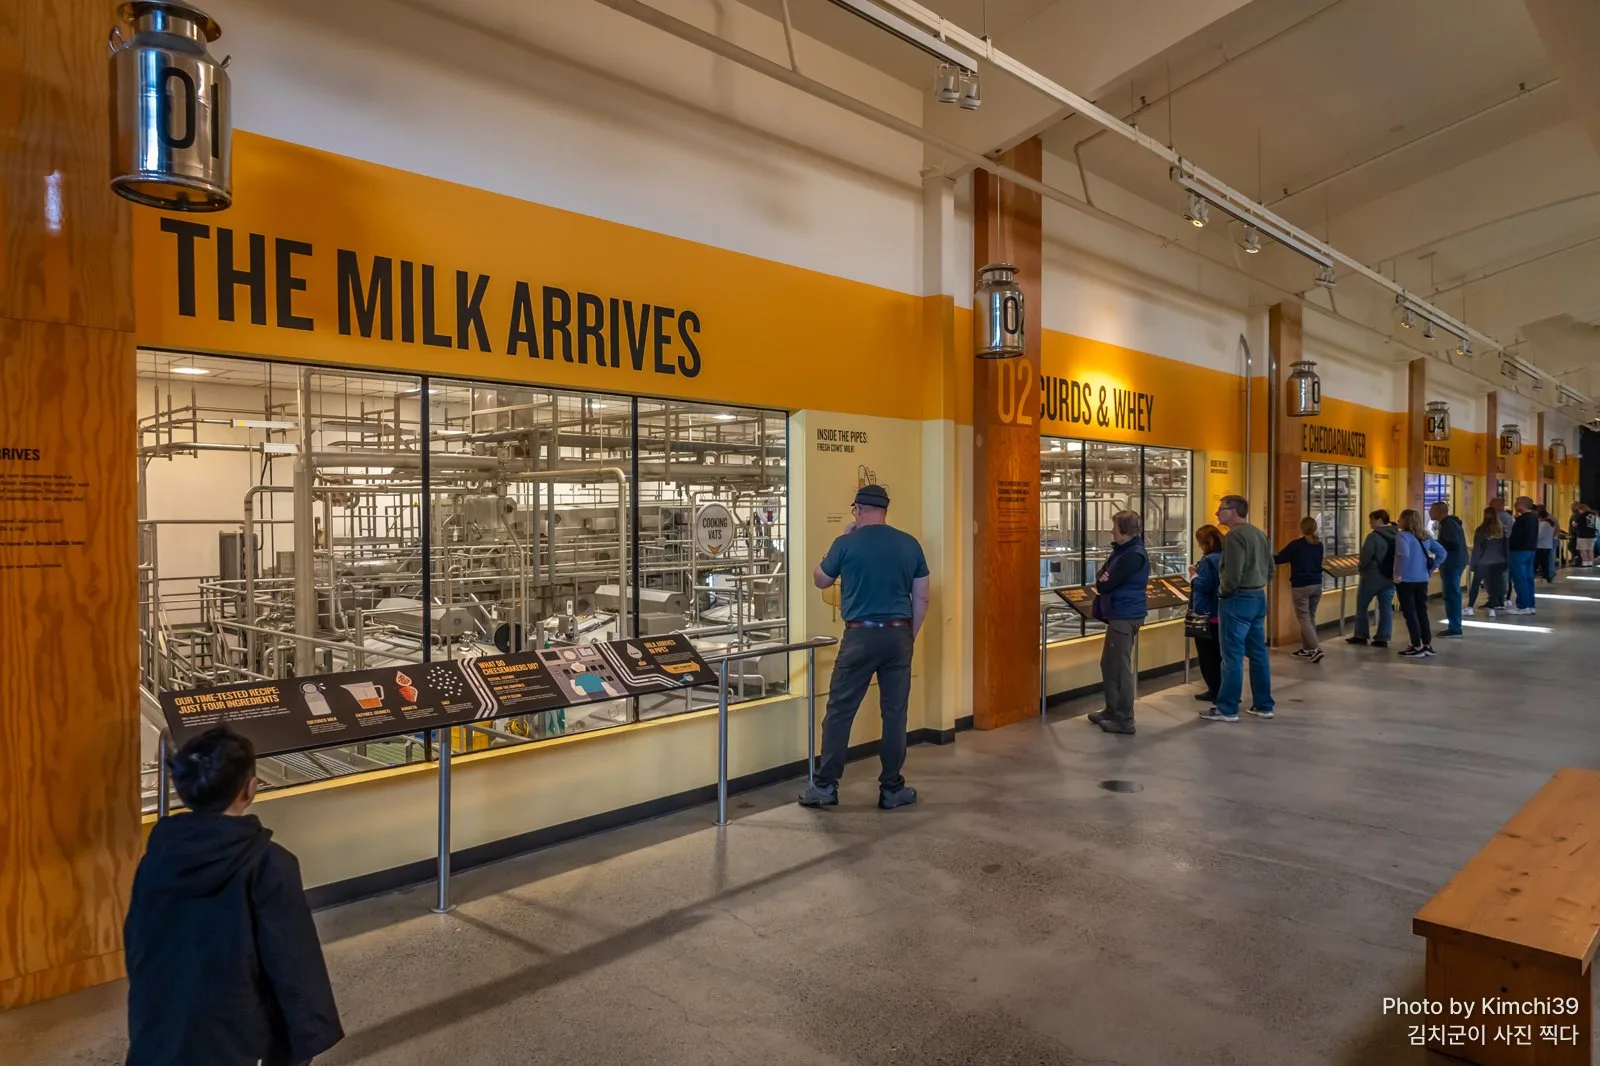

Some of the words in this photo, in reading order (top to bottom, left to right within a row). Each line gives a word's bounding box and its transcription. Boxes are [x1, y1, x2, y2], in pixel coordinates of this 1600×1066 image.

[160, 67, 219, 159] 01
[160, 217, 314, 332] THE
[336, 248, 492, 353] MILK
[506, 281, 701, 378] ARRIVES
[997, 358, 1033, 425] 02
[1097, 385, 1109, 427] &
[1113, 388, 1154, 432] WHEY
[1428, 416, 1445, 433] 04
[817, 428, 837, 441] INSIDE
[838, 430, 849, 442] THE
[1309, 424, 1366, 459] CHEDDARMASTER
[0, 448, 40, 461] RIVES
[702, 517, 728, 528] COOKING
[707, 530, 722, 540] VATS
[478, 660, 496, 669] WHAT
[495, 659, 506, 667] DO
[482, 663, 528, 675] CHEESEMAKERS
[174, 697, 194, 706] OUR
[194, 690, 248, 703] TIME-TESTED
[178, 705, 201, 714] JUST
[202, 701, 226, 712] FOUR
[226, 694, 280, 708] INGREDIENTS
